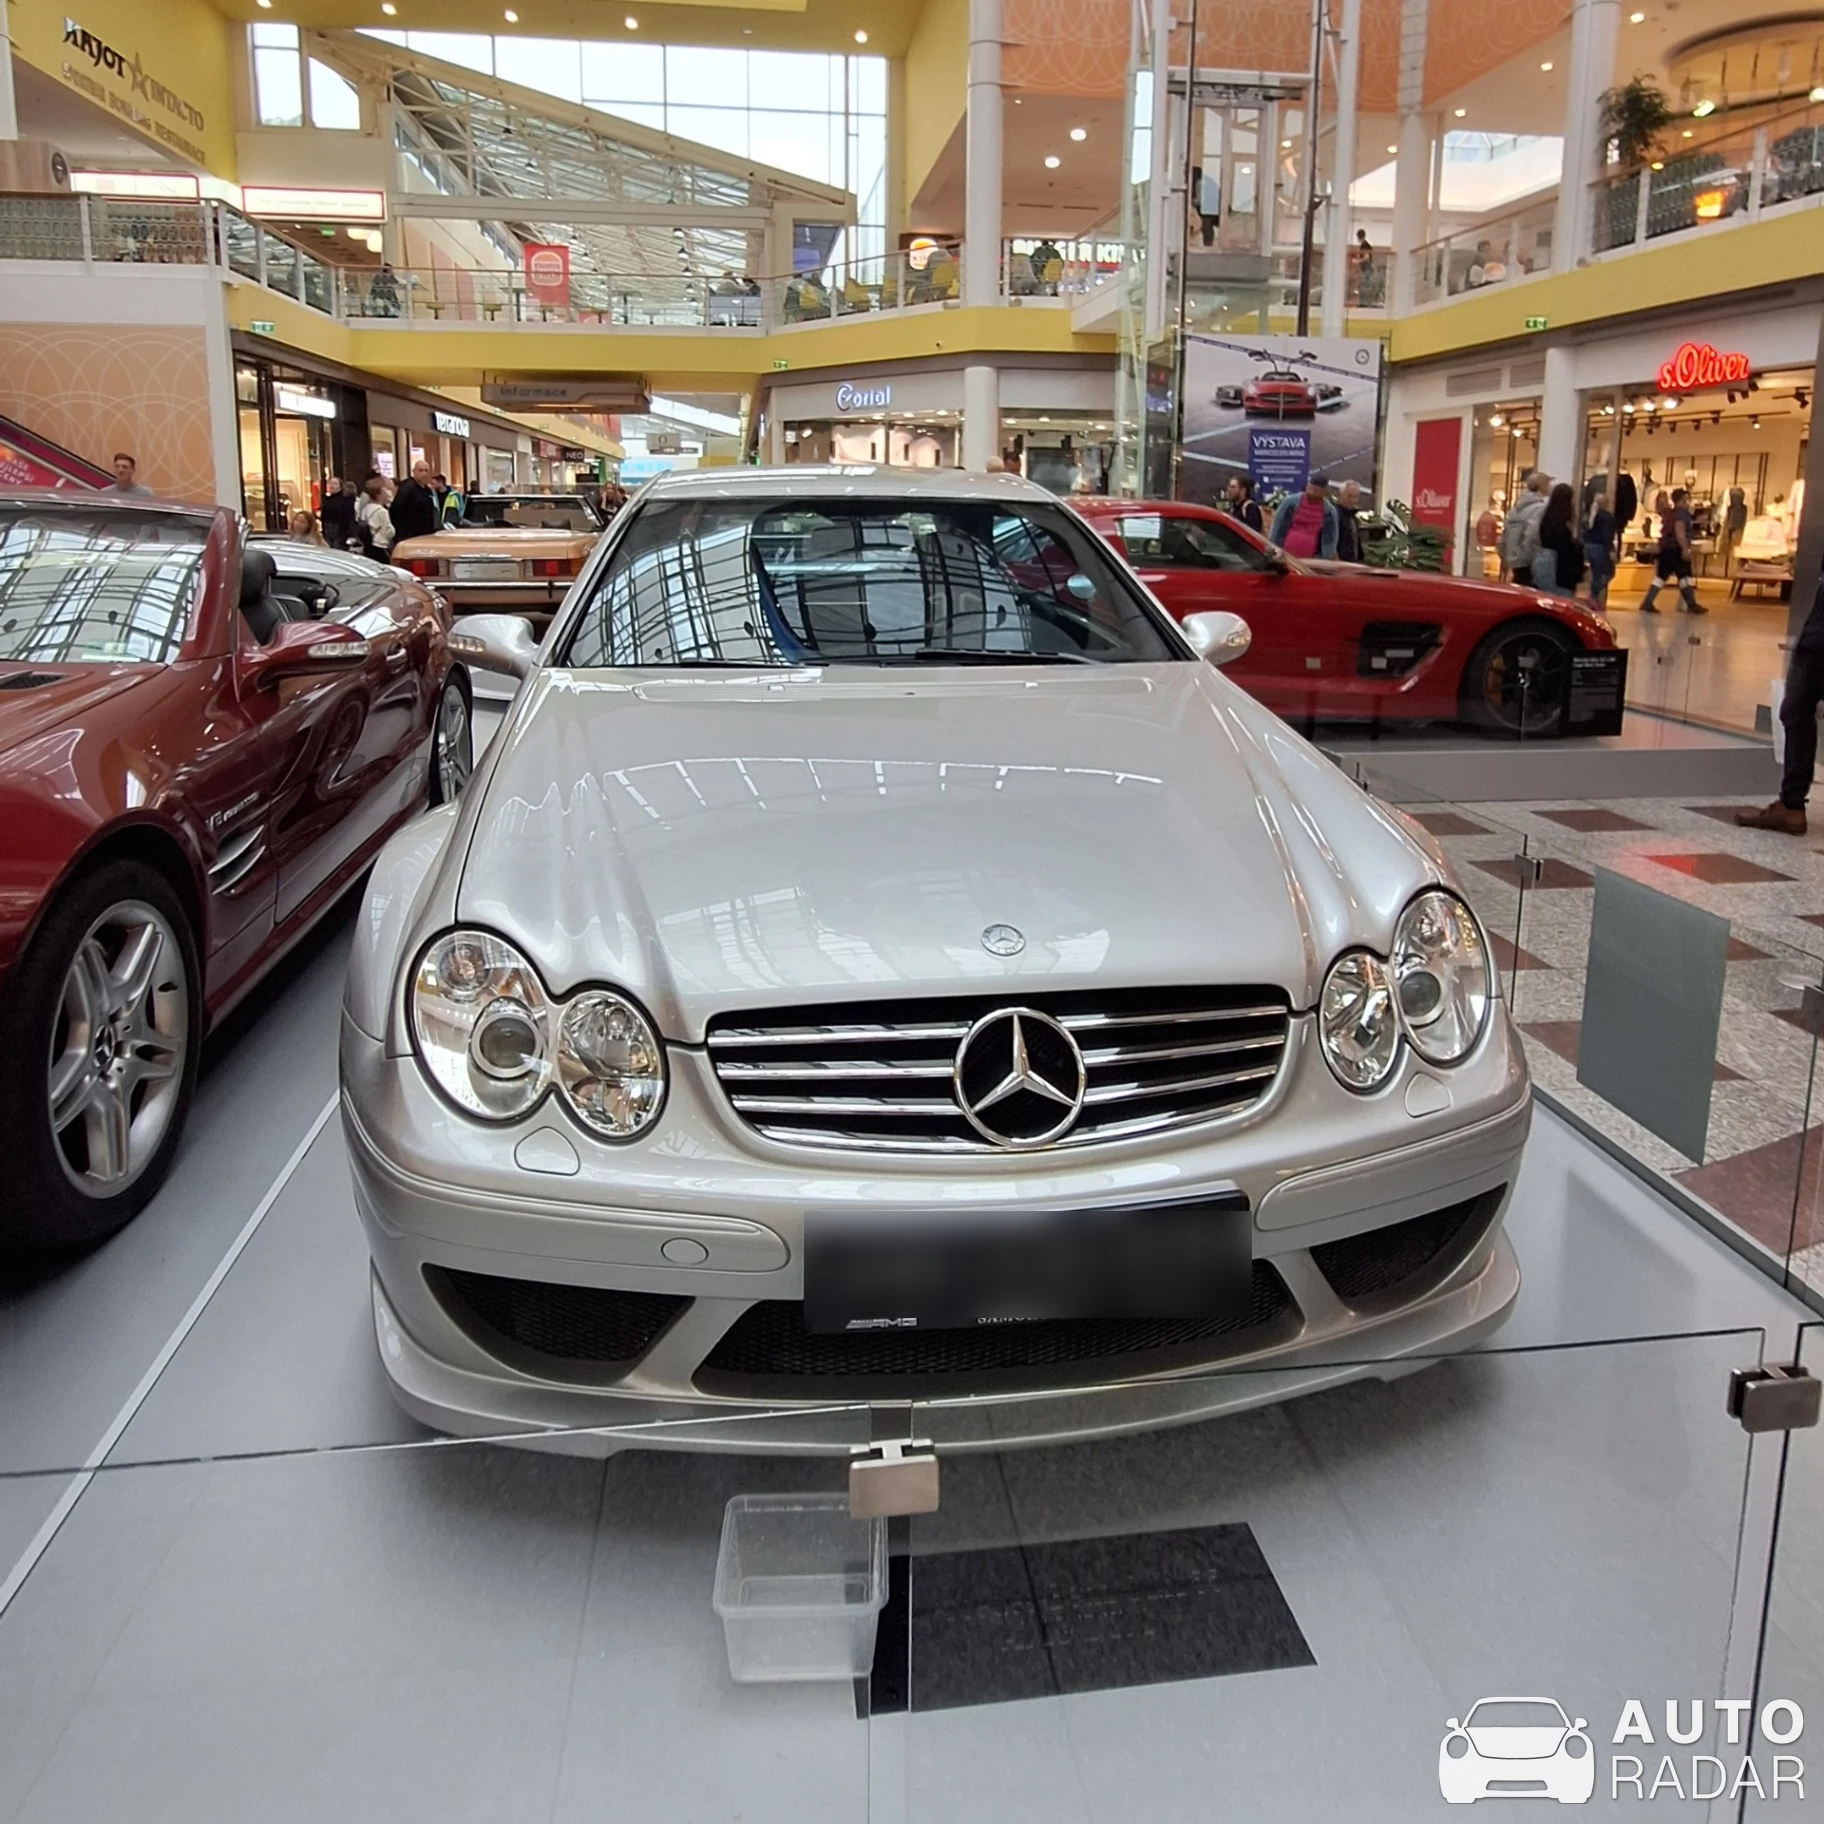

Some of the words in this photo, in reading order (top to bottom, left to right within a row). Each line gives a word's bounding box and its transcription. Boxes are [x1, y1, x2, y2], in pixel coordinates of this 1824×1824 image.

[1660, 343, 1748, 389] s.Oliver
[836, 383, 891, 411] Corial
[566, 451, 584, 459] NEO
